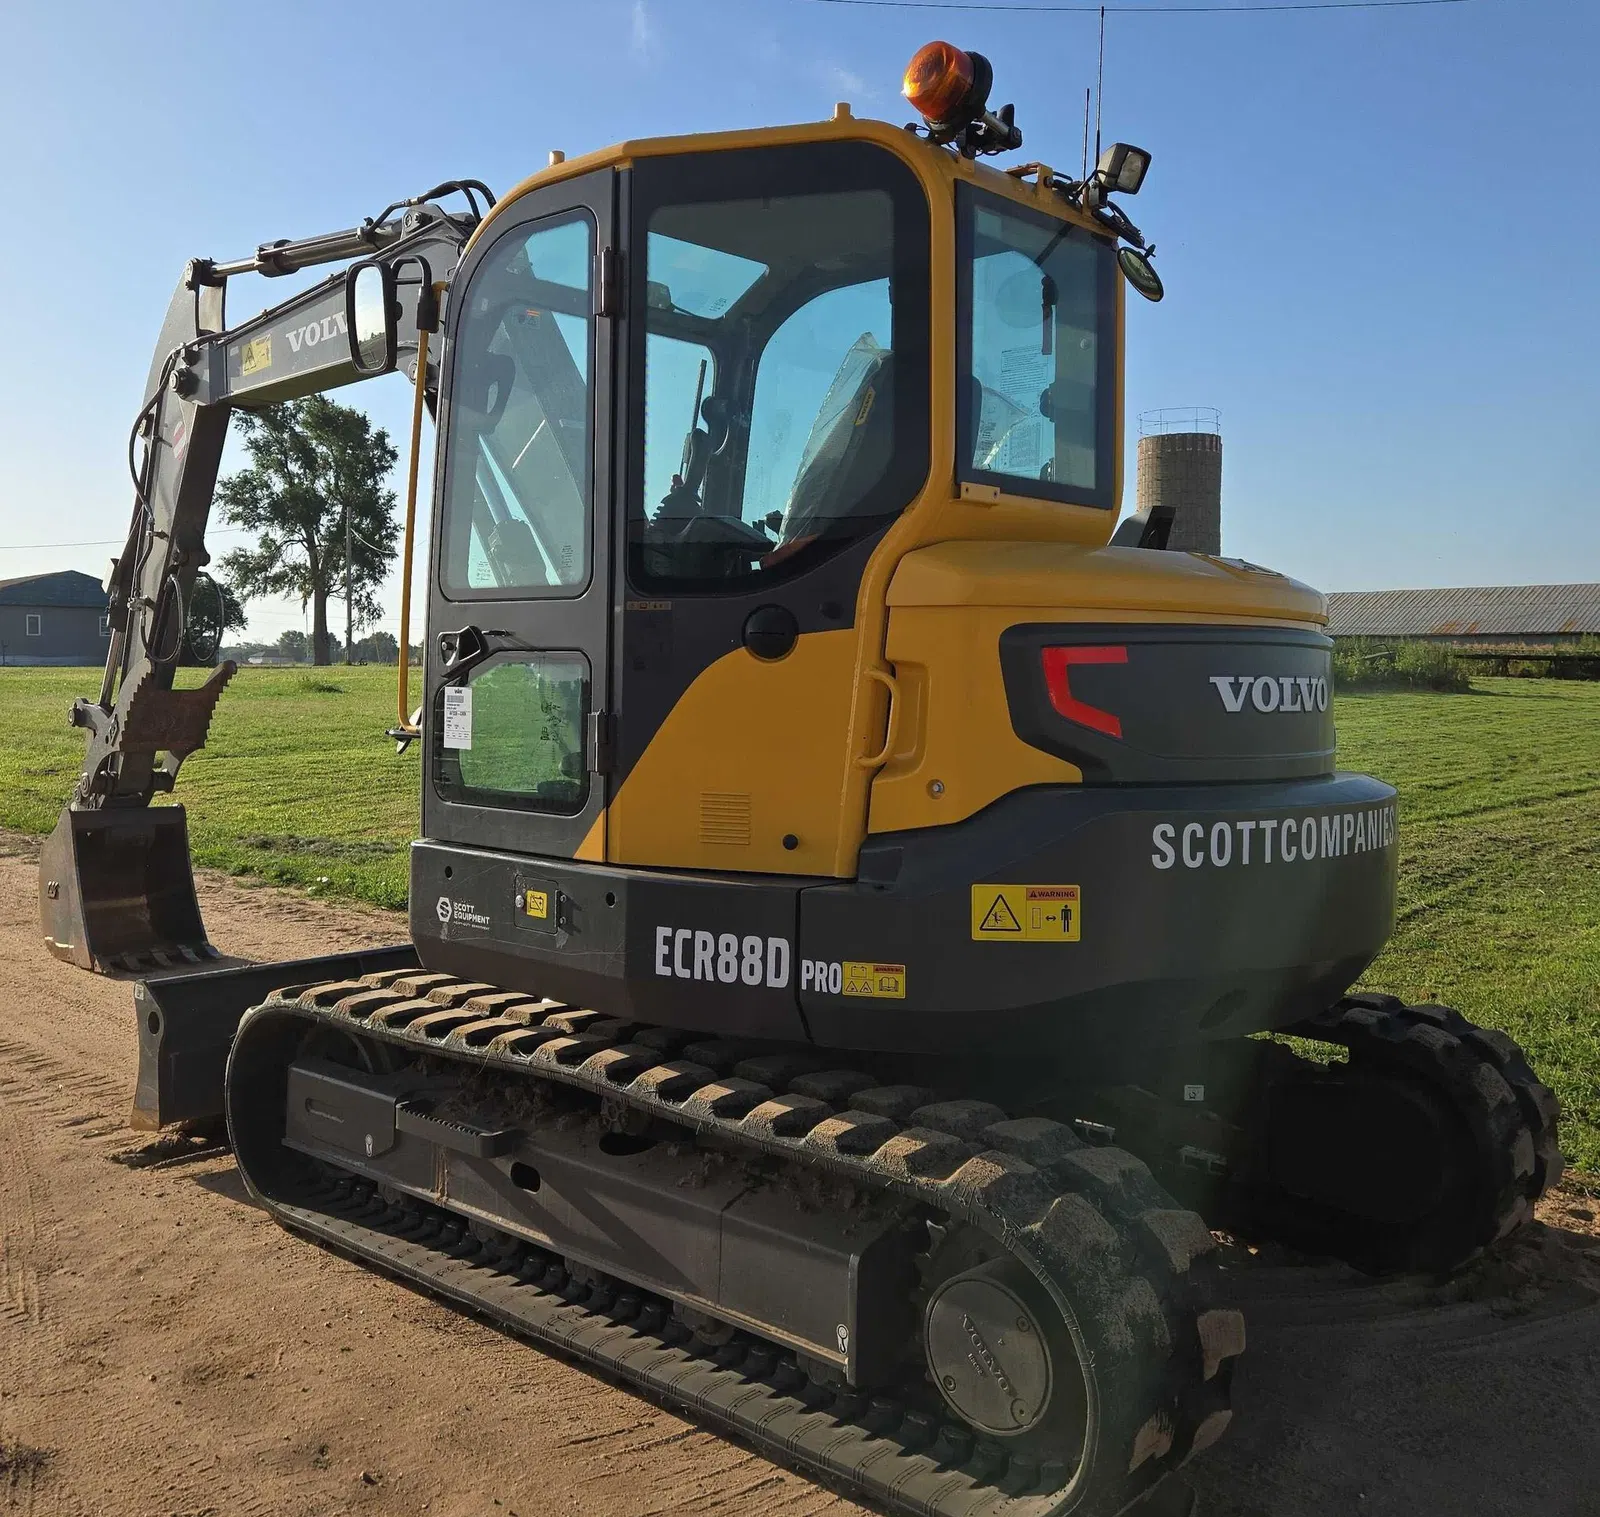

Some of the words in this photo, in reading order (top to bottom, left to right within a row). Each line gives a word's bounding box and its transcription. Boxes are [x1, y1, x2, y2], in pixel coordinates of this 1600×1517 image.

[1209, 676, 1328, 712] VOLVO
[1151, 805, 1395, 870] SCOTTCOMPANIES
[453, 902, 475, 913] SCOTT
[1037, 890, 1076, 898] WARNING
[453, 911, 490, 924] EQUIPMENT
[655, 926, 790, 988] ECR88D
[801, 959, 842, 994] PRO
